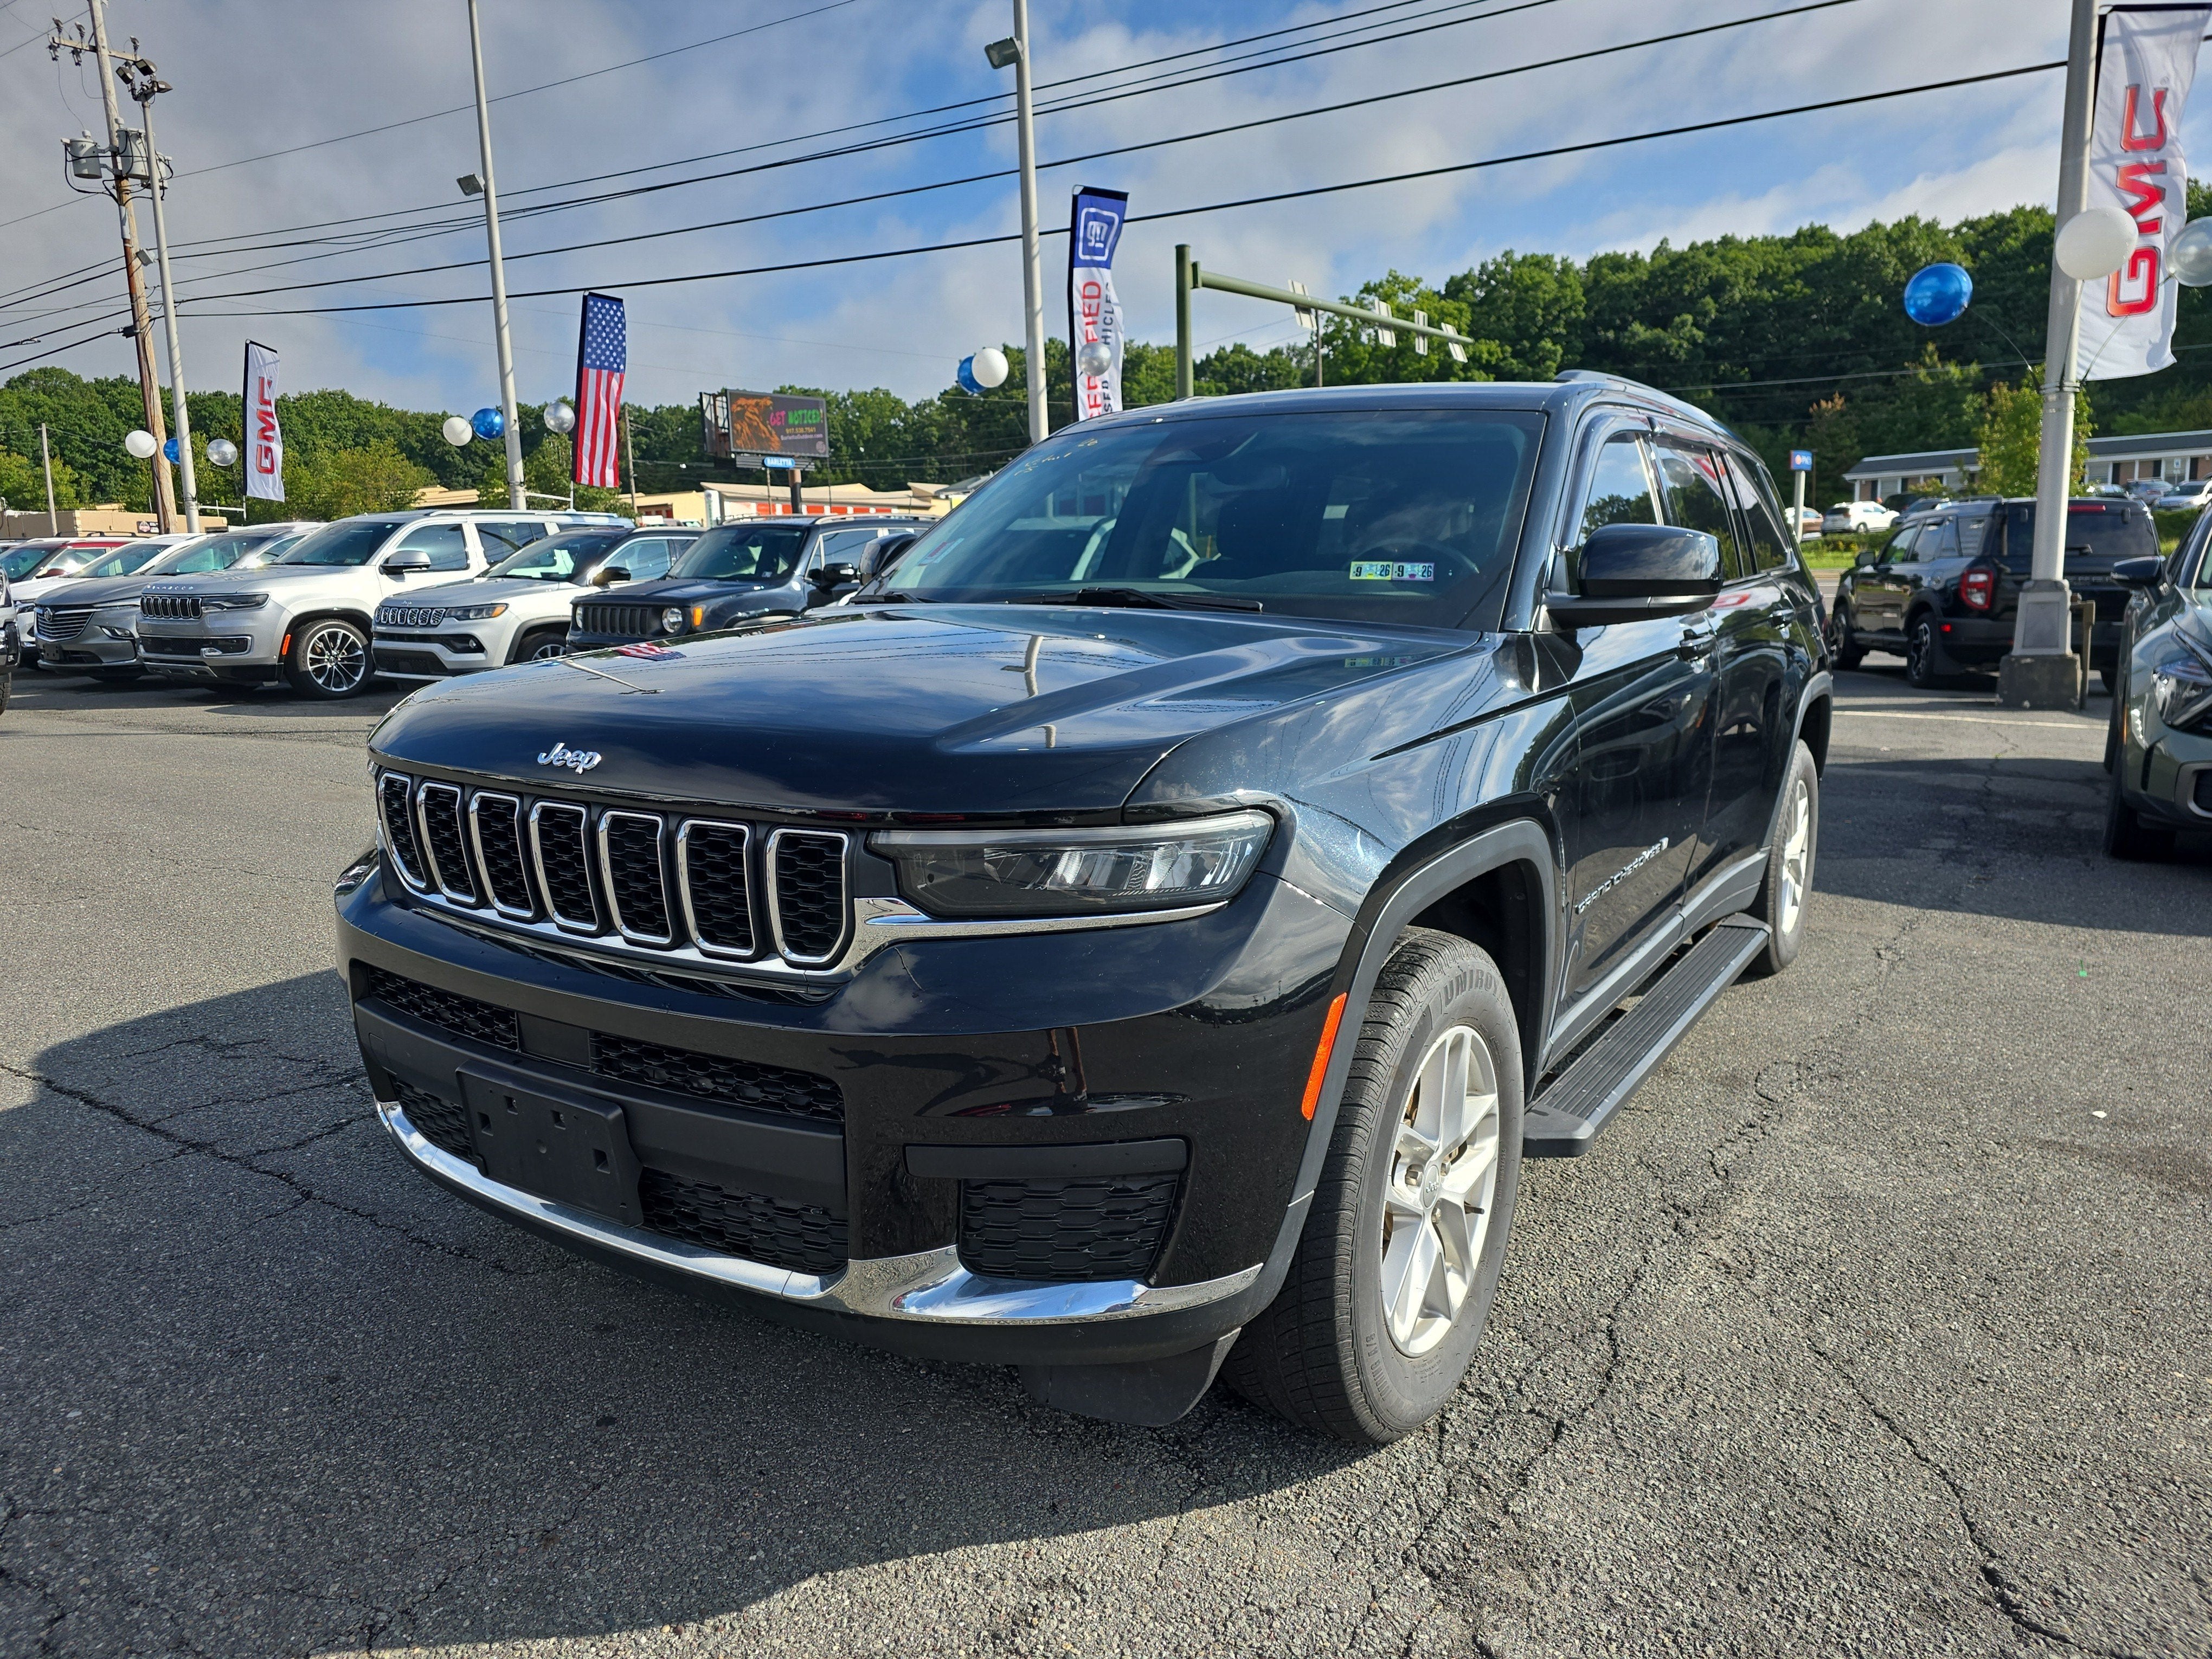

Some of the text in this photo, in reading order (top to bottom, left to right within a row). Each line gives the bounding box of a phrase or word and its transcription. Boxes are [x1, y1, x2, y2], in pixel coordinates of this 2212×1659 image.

[2106, 84, 2168, 318] GMC
[1086, 221, 1108, 248] gm
[256, 376, 276, 475] GMC
[769, 408, 824, 426] GET NOTICED!
[1356, 564, 1391, 577] 9 26
[1398, 565, 1432, 577] 9 26
[537, 742, 601, 774] Jeep
